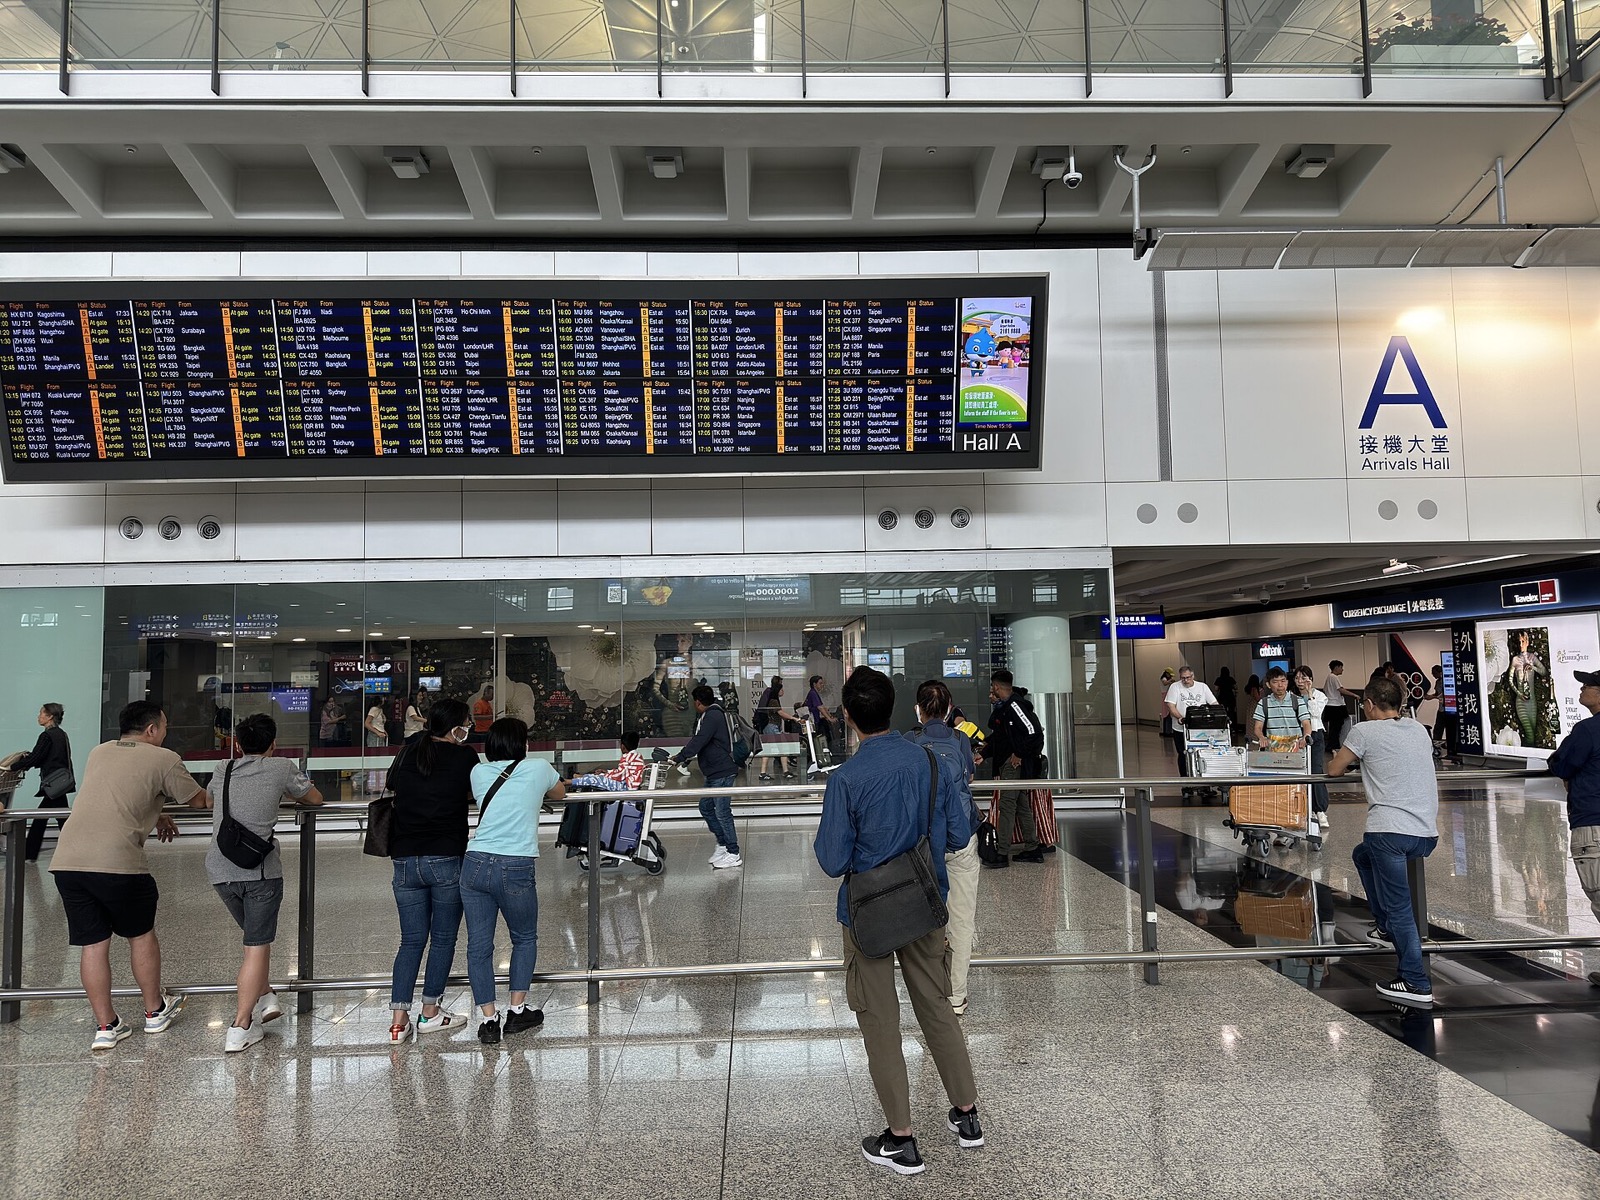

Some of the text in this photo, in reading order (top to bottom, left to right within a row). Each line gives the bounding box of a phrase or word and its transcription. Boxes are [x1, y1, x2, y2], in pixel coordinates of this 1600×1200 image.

[1358, 336, 1448, 429] A
[964, 433, 1021, 450] Hall A
[1359, 435, 1450, 454] 接機大堂
[1361, 457, 1450, 470] Arrivals Hall
[1514, 593, 1538, 603] Travelex
[1343, 603, 1406, 618] CURRENCY EXCHANGE
[1260, 644, 1282, 657] citibank
[1460, 632, 1480, 745] 外幣找換
[1566, 707, 1577, 715] your
